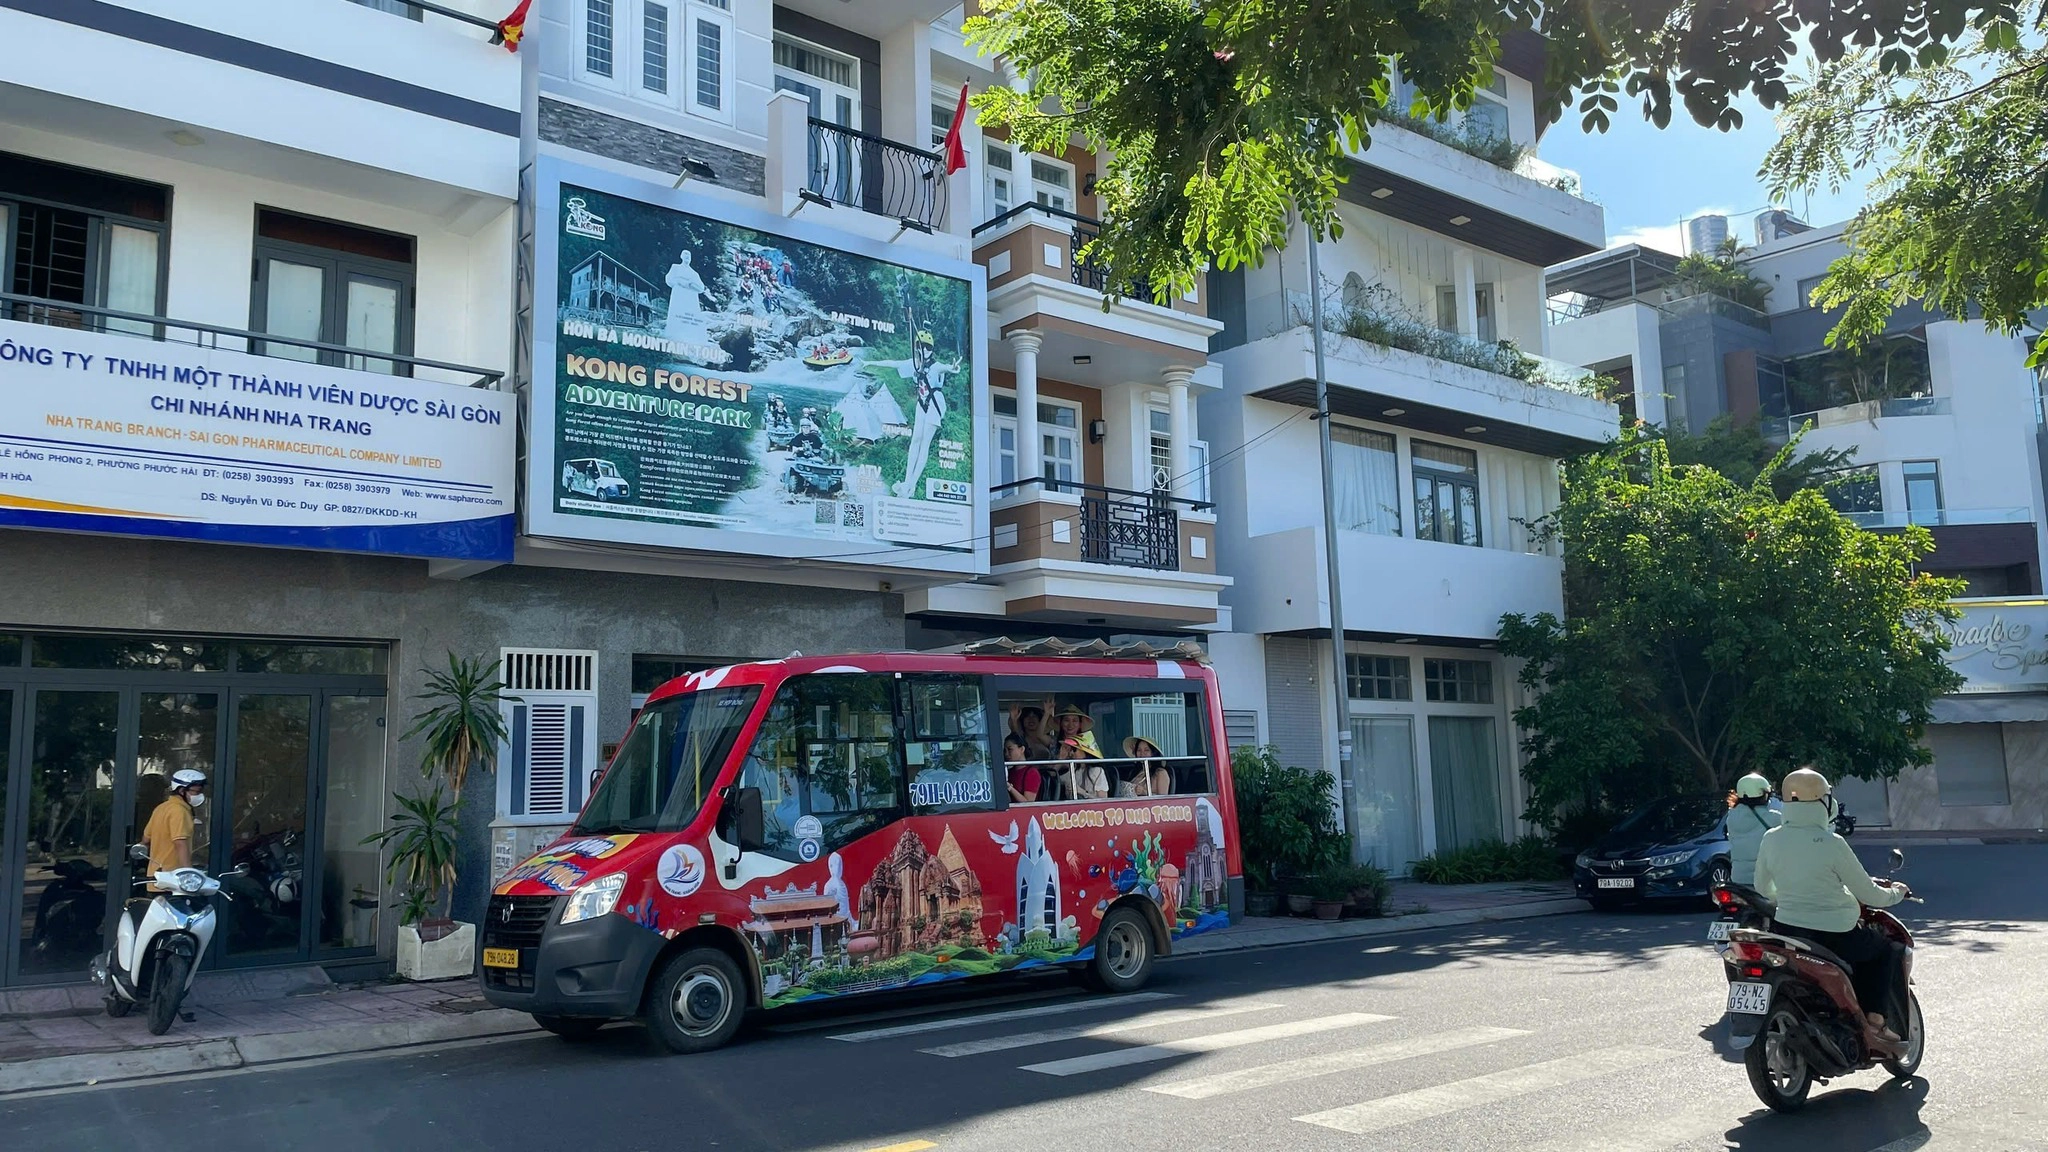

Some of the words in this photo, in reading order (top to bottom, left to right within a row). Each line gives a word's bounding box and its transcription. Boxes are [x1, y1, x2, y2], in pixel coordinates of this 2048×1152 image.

[831, 311, 869, 329] RAFTING
[871, 319, 895, 334] TOUR
[622, 331, 689, 355] MOUNTAIN
[692, 344, 726, 362] TOUR
[62, 350, 93, 371] TY
[105, 356, 166, 381] TNHH
[173, 366, 222, 391] MỘT
[229, 374, 302, 399] THÀNH
[308, 383, 354, 407] VIÊN
[360, 391, 419, 416] DƯỢC
[425, 399, 455, 420] SÀI
[461, 404, 501, 426] GÒN
[566, 353, 647, 387] KONG
[654, 368, 752, 404] FOREST
[151, 395, 183, 413] CHI
[189, 397, 258, 423] NHÁNH
[263, 409, 303, 428] NHA
[308, 415, 372, 437] TRANG
[565, 384, 695, 420] ADVENTURE
[697, 404, 751, 429] PARK
[46, 414, 74, 428] NHA
[76, 417, 123, 433] TRANG
[127, 423, 182, 440] BRANCH
[189, 433, 209, 444] SAI
[213, 435, 239, 447] GON
[242, 438, 347, 459] PHARMACEUTICAL
[350, 449, 399, 464] COMPANY
[402, 455, 442, 469] LIMITED
[882, 424, 912, 437] CAMPING
[939, 439, 964, 450] ZIPLINE
[939, 450, 965, 461] CANOPY
[11, 471, 32, 482] HÒA
[858, 464, 882, 478] ATV
[939, 459, 957, 470] TOUR
[15, 450, 44, 461] HỒNG
[48, 454, 83, 465] PHONG
[97, 458, 140, 470] PHƯỜNG
[143, 463, 178, 474] PHƯỚC
[222, 470, 252, 482] (0258)
[255, 474, 294, 485] 3903993
[304, 479, 324, 489] Fax:
[325, 480, 352, 492] (0258)
[355, 484, 391, 495] 3903979
[402, 488, 423, 498] Web:
[425, 491, 503, 506] www.sapharco.com
[201, 492, 218, 502] DS:
[221, 494, 258, 506] Nguyễn
[260, 497, 273, 507] Vũ
[276, 499, 296, 509] Đức
[300, 501, 318, 512] Duy
[323, 503, 340, 513] GP:
[909, 780, 992, 807] 79H-048.28
[1042, 809, 1105, 830] WELCOME
[1105, 807, 1124, 827] TO
[1125, 807, 1151, 825] NHA
[1151, 805, 1192, 823] TRANG
[1729, 997, 1767, 1012] 054.45
